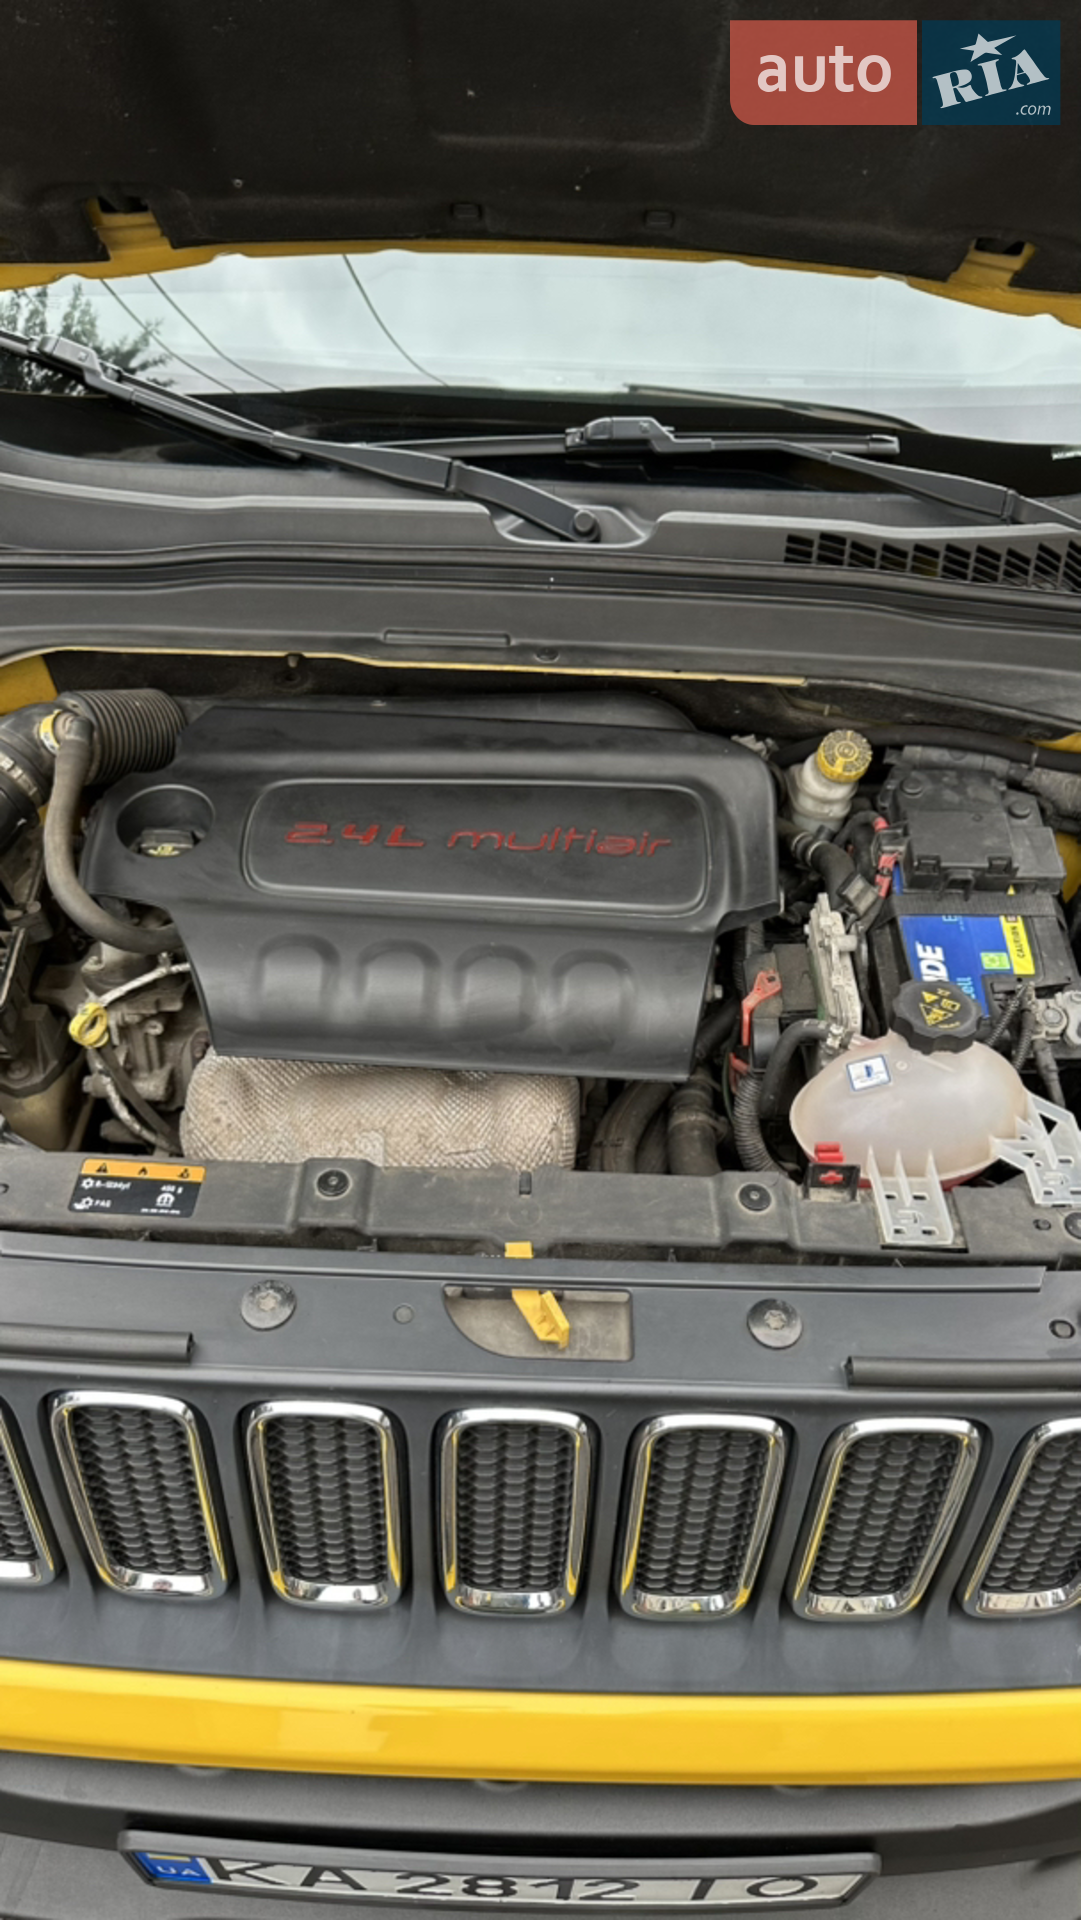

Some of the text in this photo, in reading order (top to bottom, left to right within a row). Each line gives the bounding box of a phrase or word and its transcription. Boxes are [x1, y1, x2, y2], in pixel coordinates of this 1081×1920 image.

[447, 826, 672, 856] multiair
[156, 1865, 201, 1877] UA
[204, 1856, 368, 1891] KA
[395, 1871, 640, 1901] 2812
